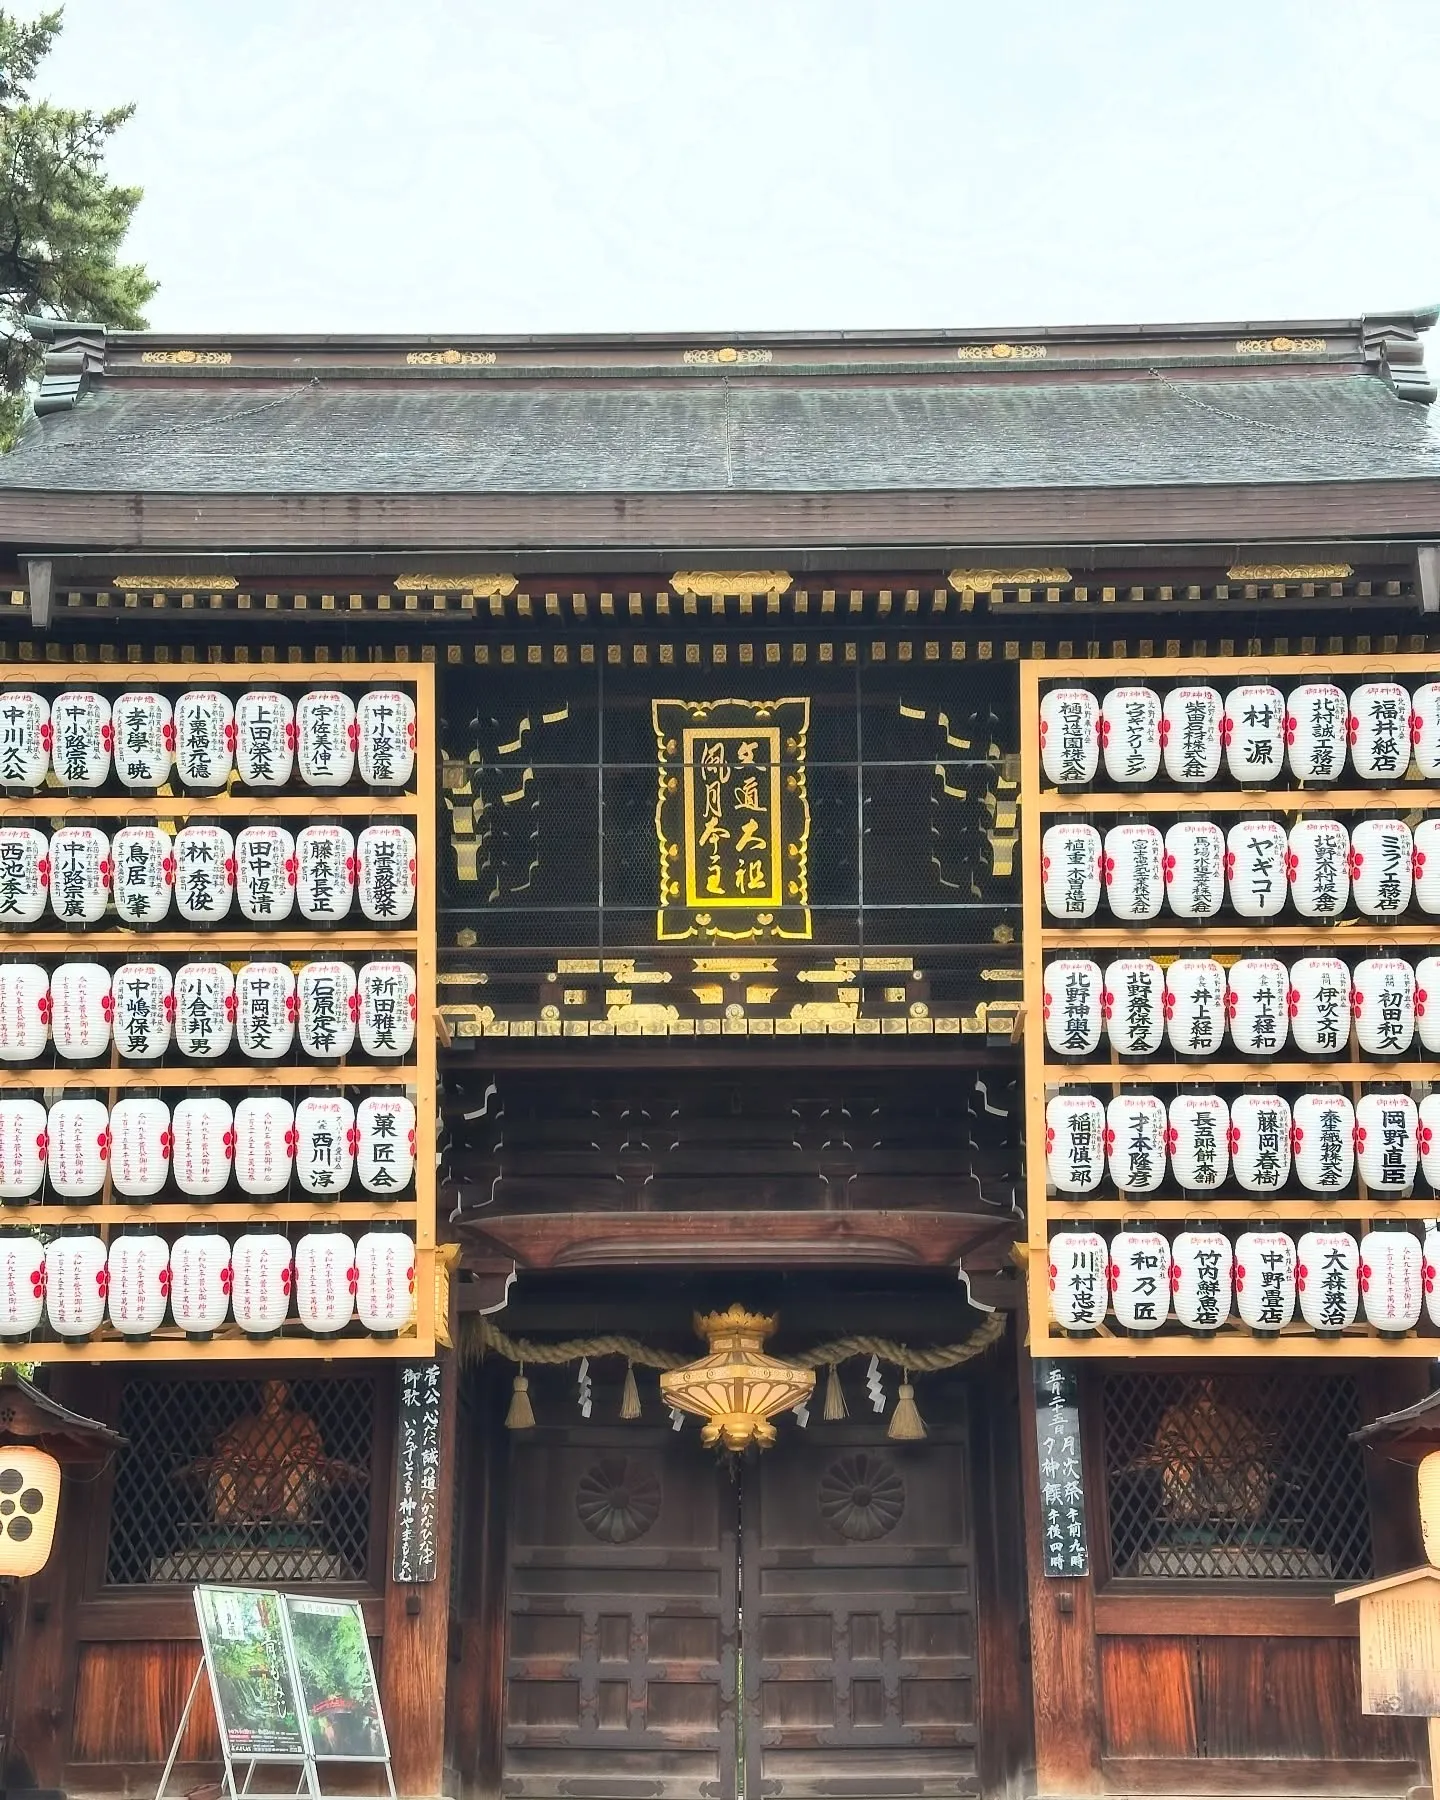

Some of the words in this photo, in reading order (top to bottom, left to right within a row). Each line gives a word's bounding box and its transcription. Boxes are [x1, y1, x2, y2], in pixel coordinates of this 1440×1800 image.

[3, 706, 27, 781] 中川久公
[63, 706, 90, 780] 中小路宗俊
[311, 705, 333, 776] 宇佐美伸二
[372, 705, 394, 779] 中小路宗隆
[1059, 702, 1086, 781] 樋口造園株式会社
[1125, 702, 1146, 776] ウサギヤクリーニング
[1181, 700, 1208, 777] 柴田石材株式会社
[1242, 704, 1273, 765] 材源
[1309, 698, 1336, 775] 北村誠工務店
[1368, 700, 1399, 771] 福井紙店
[0, 843, 27, 915] 西池季久
[310, 839, 334, 913] 藤森長正
[373, 841, 398, 916] 出雲路敬栄
[1190, 836, 1212, 913] 馬場水道工業株式会社
[1247, 838, 1274, 908] ヤギコー
[1312, 835, 1338, 912] 北野木村板金店
[1374, 835, 1401, 910] ミラノ工務店
[125, 979, 150, 1053] 中嶋保男
[187, 979, 213, 1054] 小倉邦男
[250, 979, 272, 1049] 中岡英文
[310, 978, 337, 1052] 石原定祥
[371, 977, 398, 1050] 新田雅美
[1060, 972, 1091, 1050] 北野神輿会
[1125, 972, 1154, 1051] 北野祭保存会
[1188, 988, 1213, 1049] 井上経和
[1250, 988, 1277, 1049] 井上経和
[1313, 987, 1339, 1048] 伊吹文明
[1376, 989, 1403, 1049] 初田和久
[310, 1133, 334, 1187] 西川淳
[369, 1113, 399, 1187] 菓匠会
[1067, 1113, 1091, 1187] 稲田慎一郎
[1125, 1112, 1154, 1187] 才本隆彦
[1251, 1110, 1281, 1186] 藤岡春樹
[1316, 1109, 1343, 1186] 泰生織物株式会社
[1380, 1110, 1409, 1184] 岡野直臣
[1068, 1252, 1096, 1323] 川村忠史
[1130, 1251, 1158, 1320] 和乃匠
[1192, 1250, 1222, 1324] 竹内鮮魚店
[1257, 1251, 1285, 1324] 中野畳店
[1320, 1248, 1349, 1325] 大森英治
[1066, 1508, 1085, 1569] 午前九時
